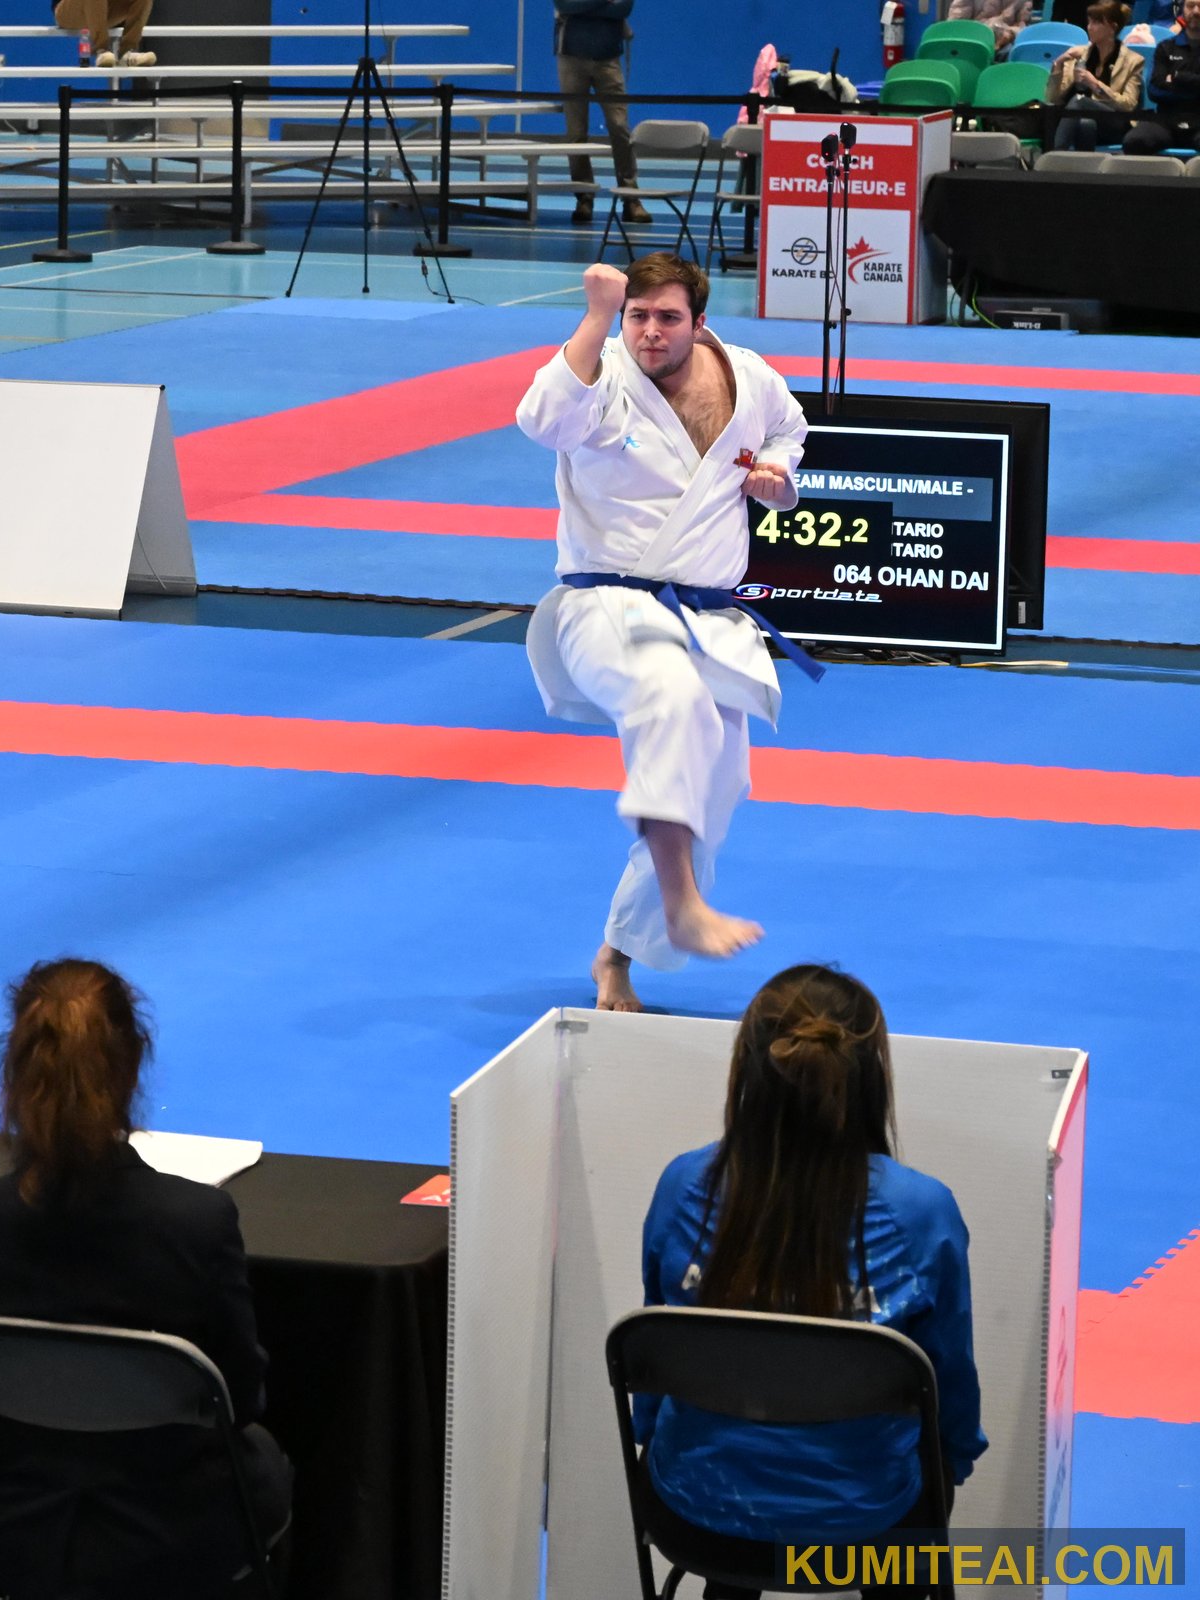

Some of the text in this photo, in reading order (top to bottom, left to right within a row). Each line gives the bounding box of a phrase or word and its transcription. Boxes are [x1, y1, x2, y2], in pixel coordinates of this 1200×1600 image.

[772, 268, 816, 279] KARATE
[863, 262, 902, 273] KARATE
[863, 272, 903, 283] CANADA
[794, 473, 825, 490] EAM
[829, 475, 963, 496] MASCULIN/MALE
[892, 521, 944, 539] TARIO
[892, 542, 943, 560] TARIO
[833, 564, 989, 591] 064 OHAN DAI
